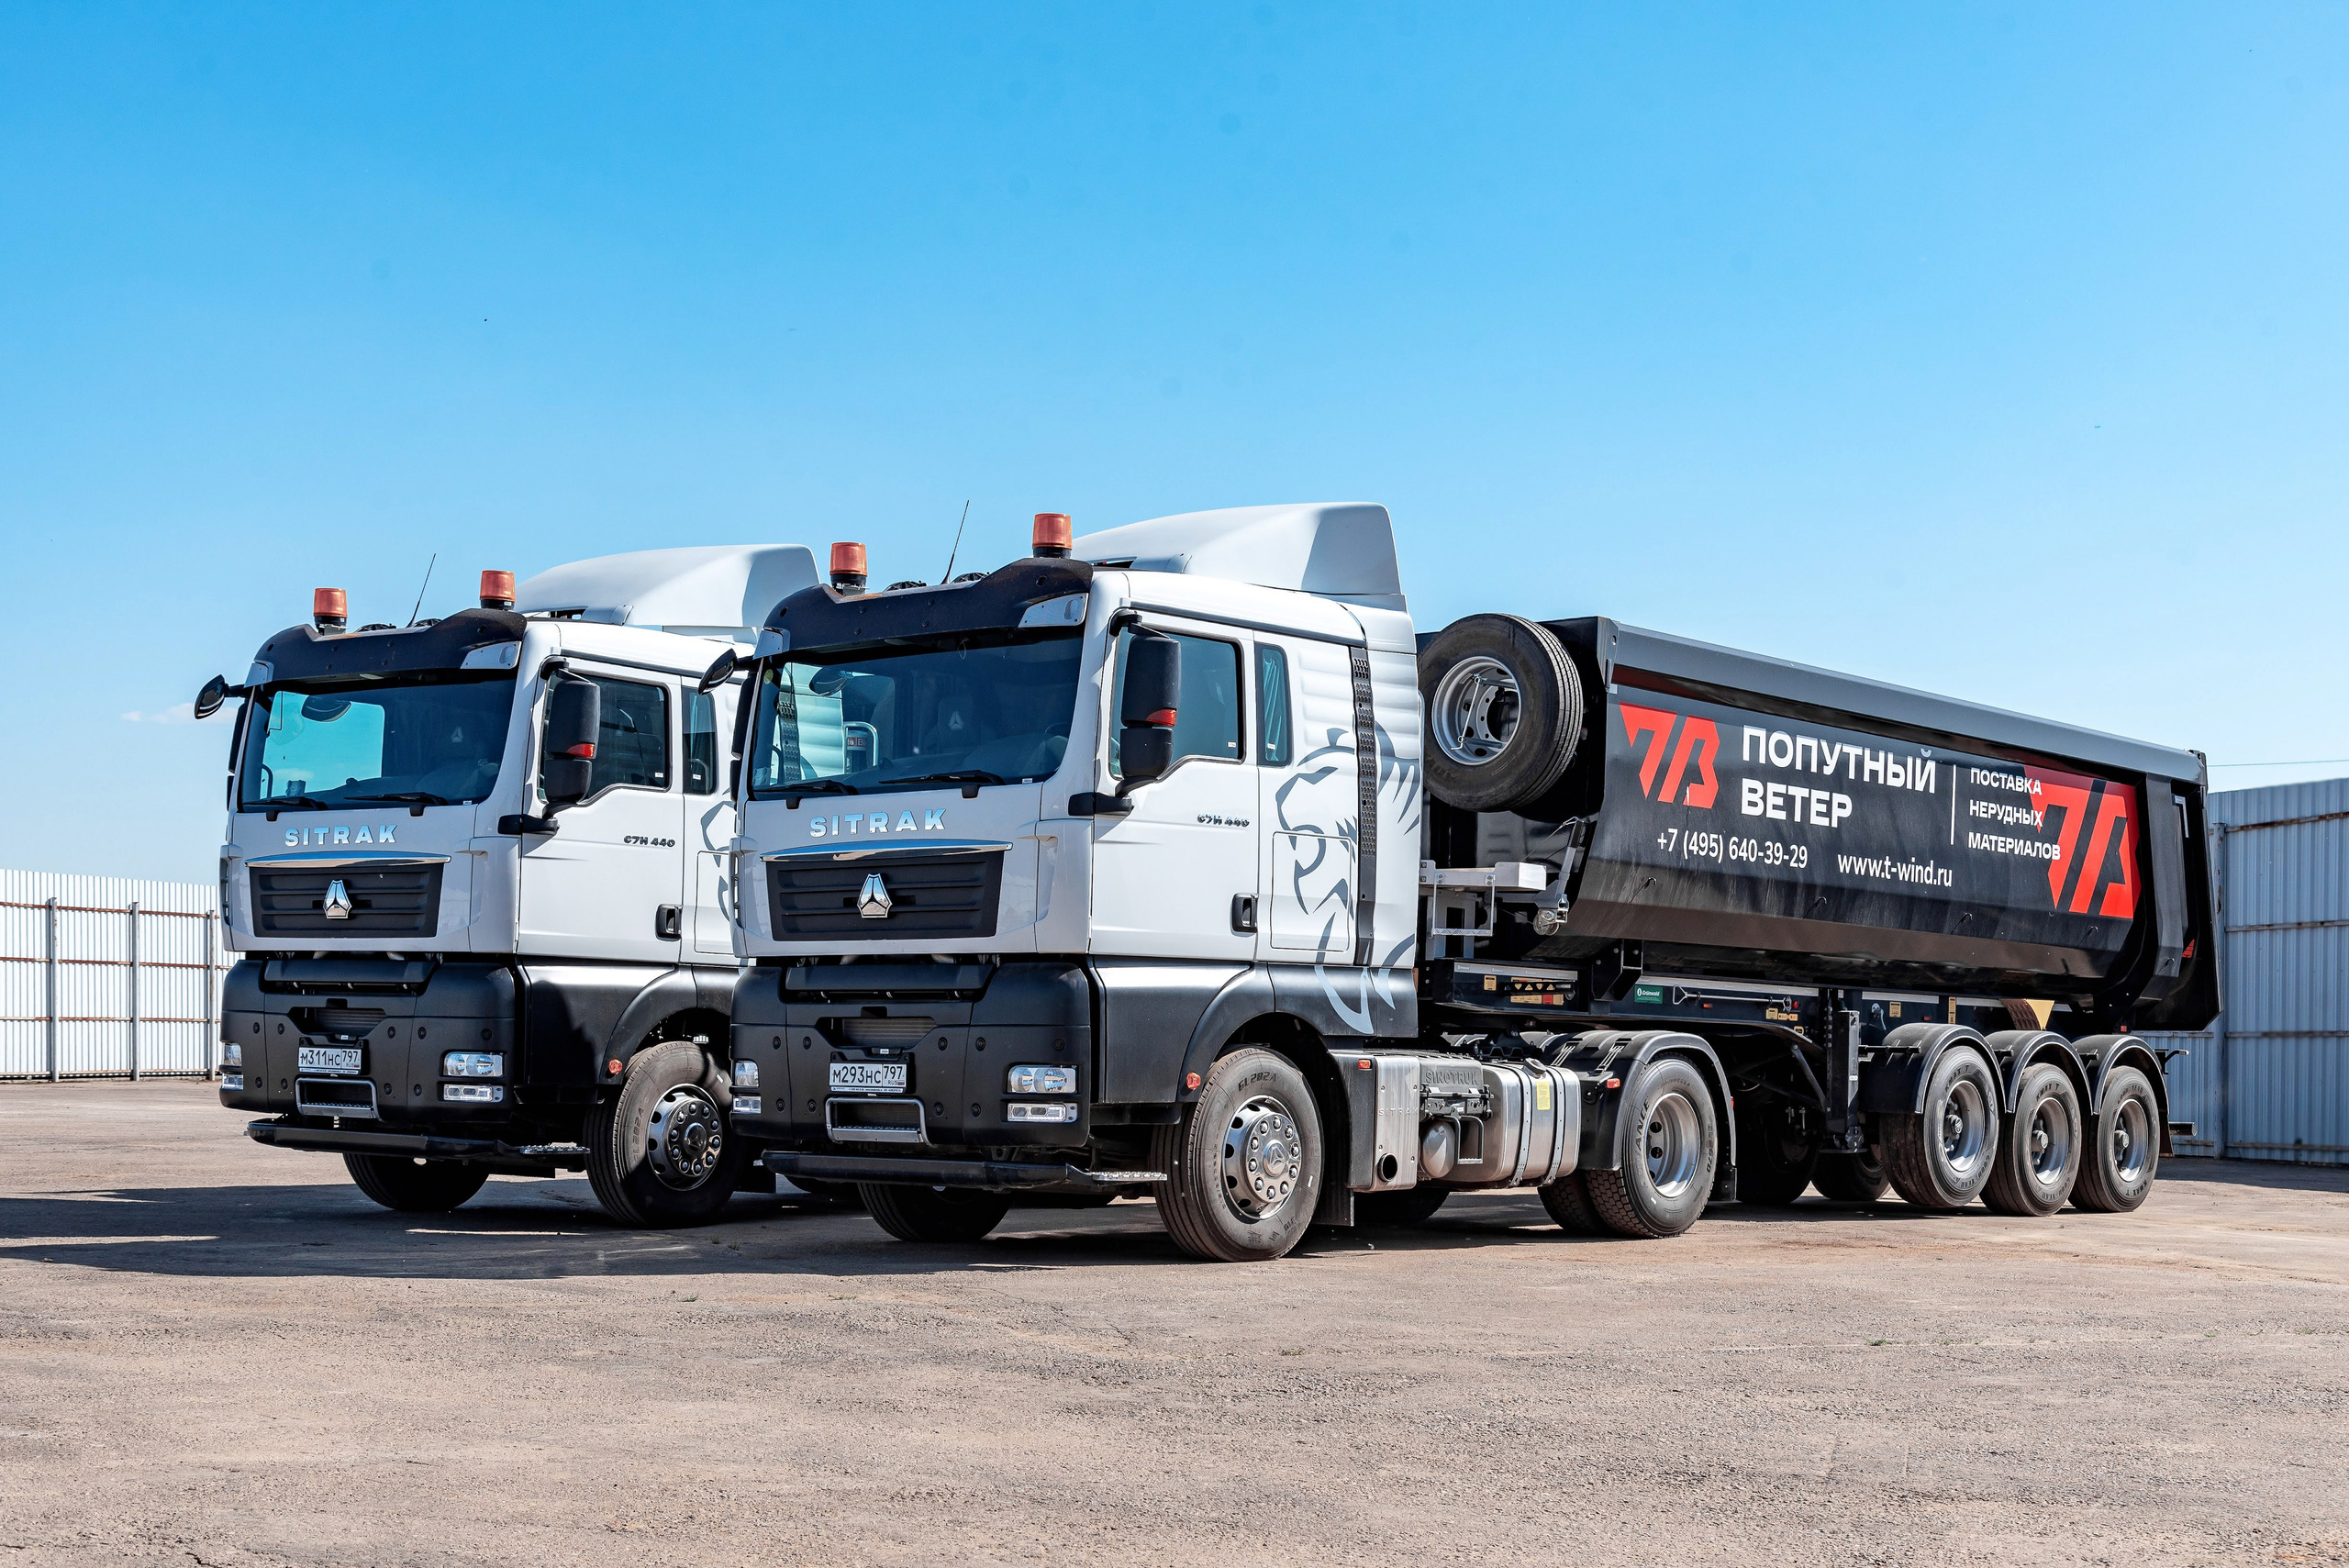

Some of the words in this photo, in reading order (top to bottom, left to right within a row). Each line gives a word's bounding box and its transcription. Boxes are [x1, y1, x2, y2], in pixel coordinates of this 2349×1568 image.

[1742, 724, 1936, 795] ПОПУТНЫЙ
[1970, 767, 2043, 795] ПОСТАВКА
[1741, 777, 1853, 828] ВЕТЕР
[1969, 799, 2043, 827] НЕРУДНЫХ
[284, 824, 398, 847] SITRAK
[809, 807, 947, 838] SITRAK
[1657, 828, 1678, 852] +7
[1683, 829, 1724, 864] (495)
[1728, 836, 1809, 869] 640-39-29
[1968, 831, 2061, 861] МАТЕРИАЛОВ
[1837, 853, 1953, 887] www.t-wind.ru
[342, 1050, 359, 1062] 797
[883, 1065, 903, 1080] 797
[1424, 1070, 1479, 1085] SINOTRUK
[1378, 1107, 1419, 1117] SITRAK
